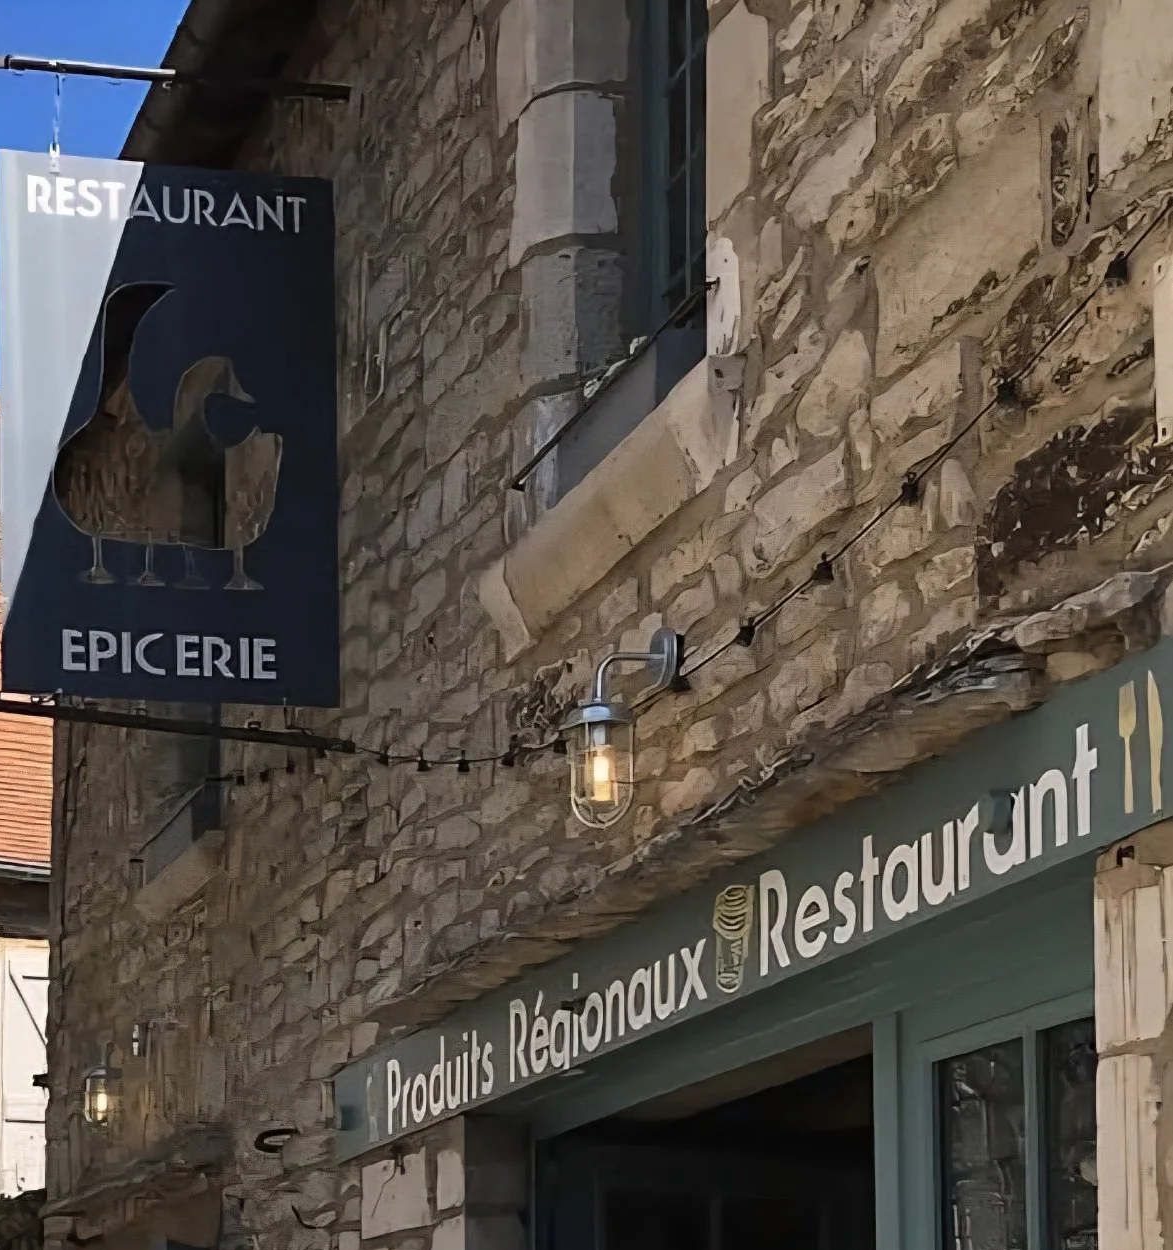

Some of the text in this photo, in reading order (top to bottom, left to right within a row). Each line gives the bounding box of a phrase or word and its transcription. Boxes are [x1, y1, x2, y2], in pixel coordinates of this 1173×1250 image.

[26, 174, 307, 233] RESTAURANT
[61, 628, 277, 681] EPICERIE
[386, 723, 1098, 1135] Produits Régionaux Restaurant
